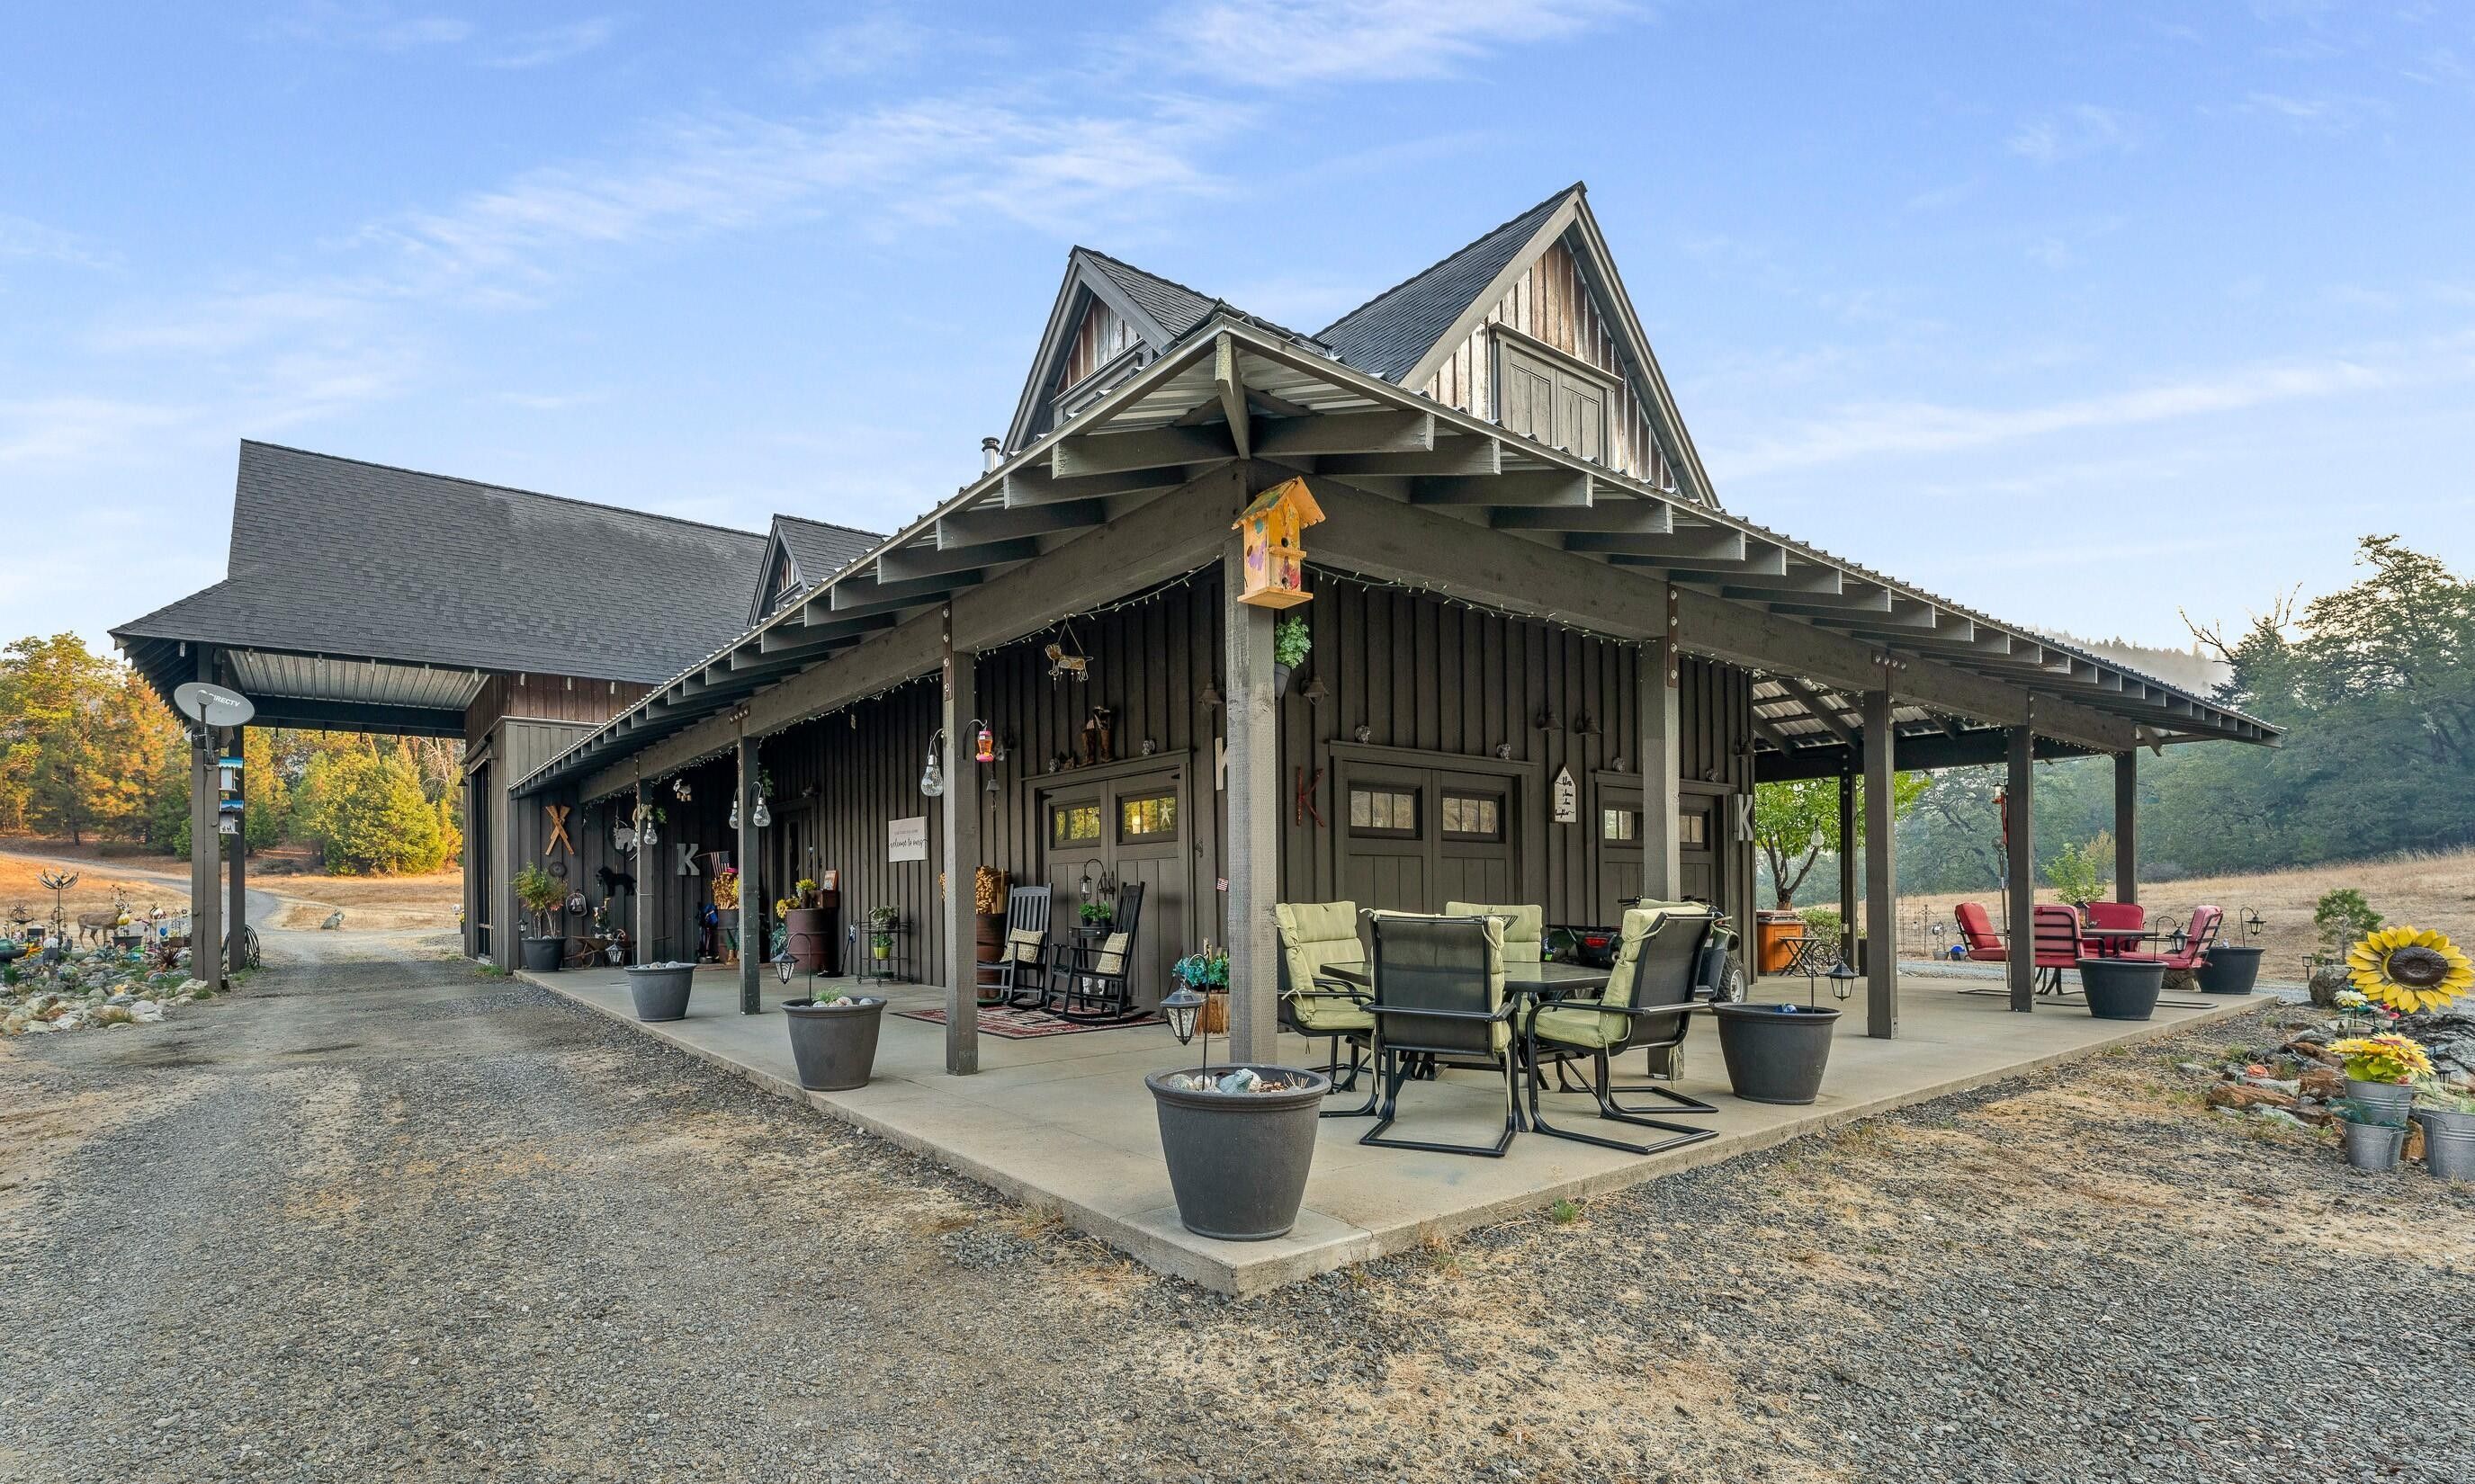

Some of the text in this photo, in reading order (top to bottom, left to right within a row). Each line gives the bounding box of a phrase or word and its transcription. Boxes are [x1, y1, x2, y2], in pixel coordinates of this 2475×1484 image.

[208, 693, 241, 707] IRECTV
[1296, 766, 1324, 827] K
[1737, 793, 1753, 841] K
[677, 843, 700, 876] K
